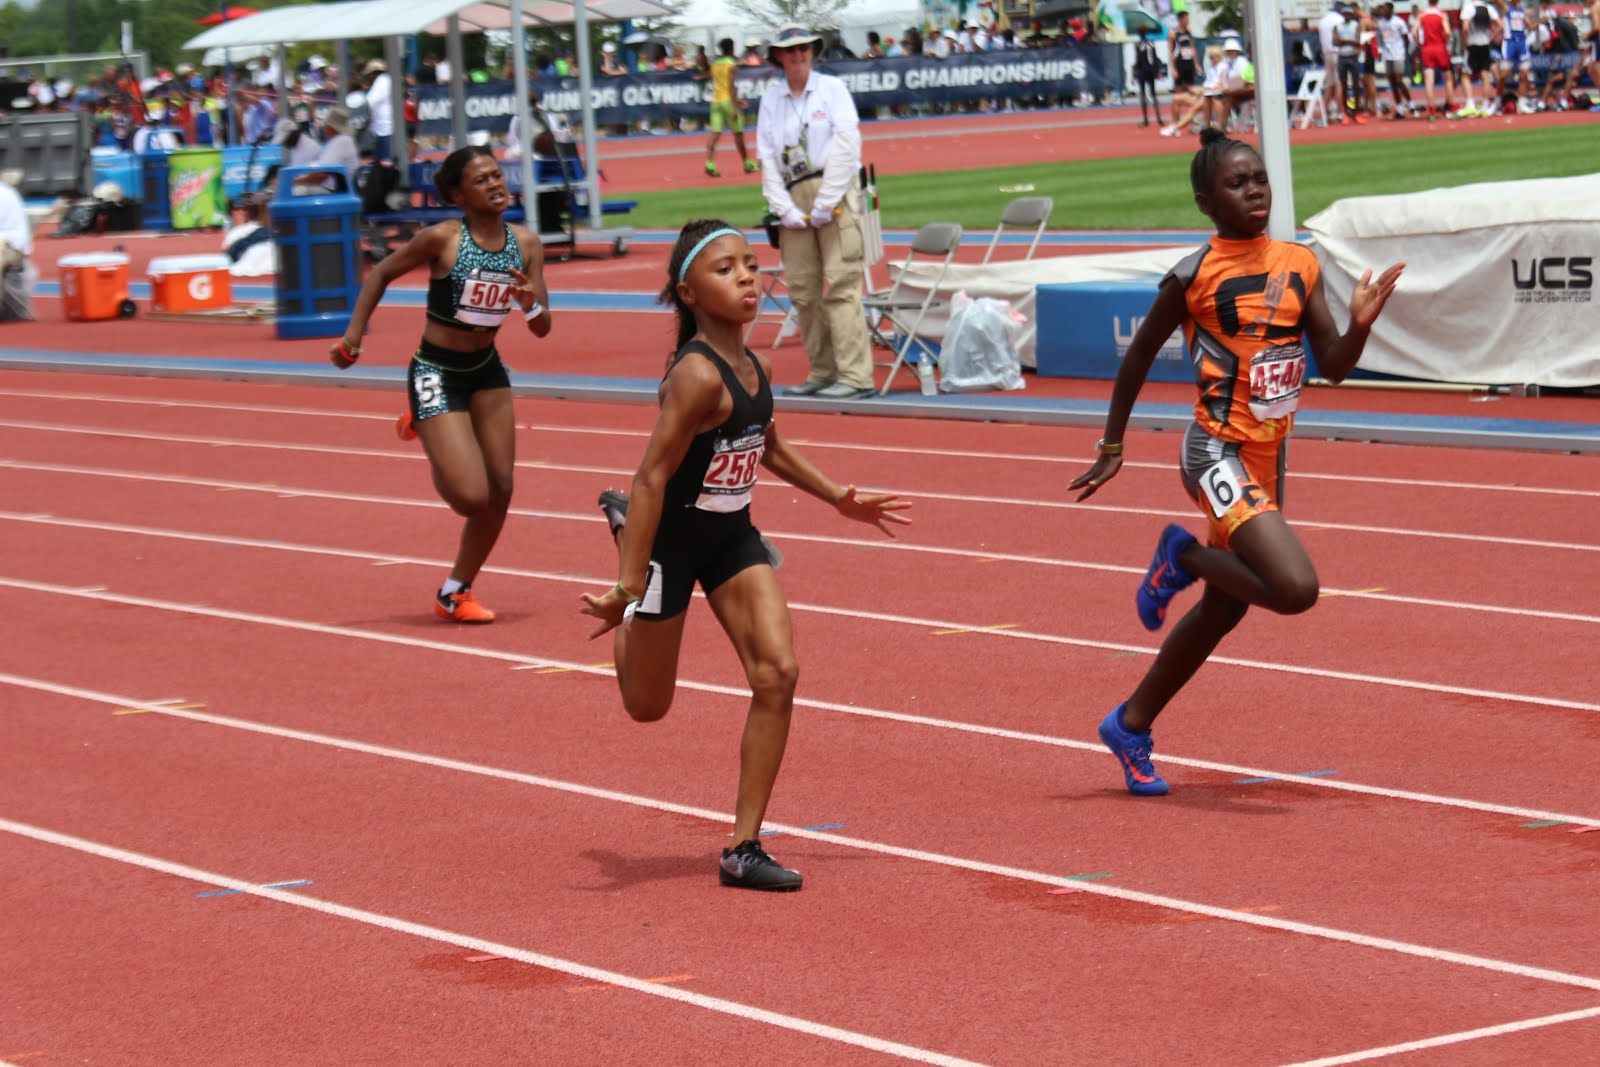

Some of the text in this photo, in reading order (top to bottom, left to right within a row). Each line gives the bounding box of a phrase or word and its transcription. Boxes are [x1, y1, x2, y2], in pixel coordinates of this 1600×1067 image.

[418, 96, 519, 120] NAONA
[539, 87, 618, 111] JUNOR
[905, 60, 1087, 89] CHAMPIONSHIPS
[188, 274, 213, 300] G
[1511, 256, 1593, 290] UCS
[470, 283, 511, 308] 504
[421, 377, 434, 403] 5
[1208, 467, 1234, 507] 6
